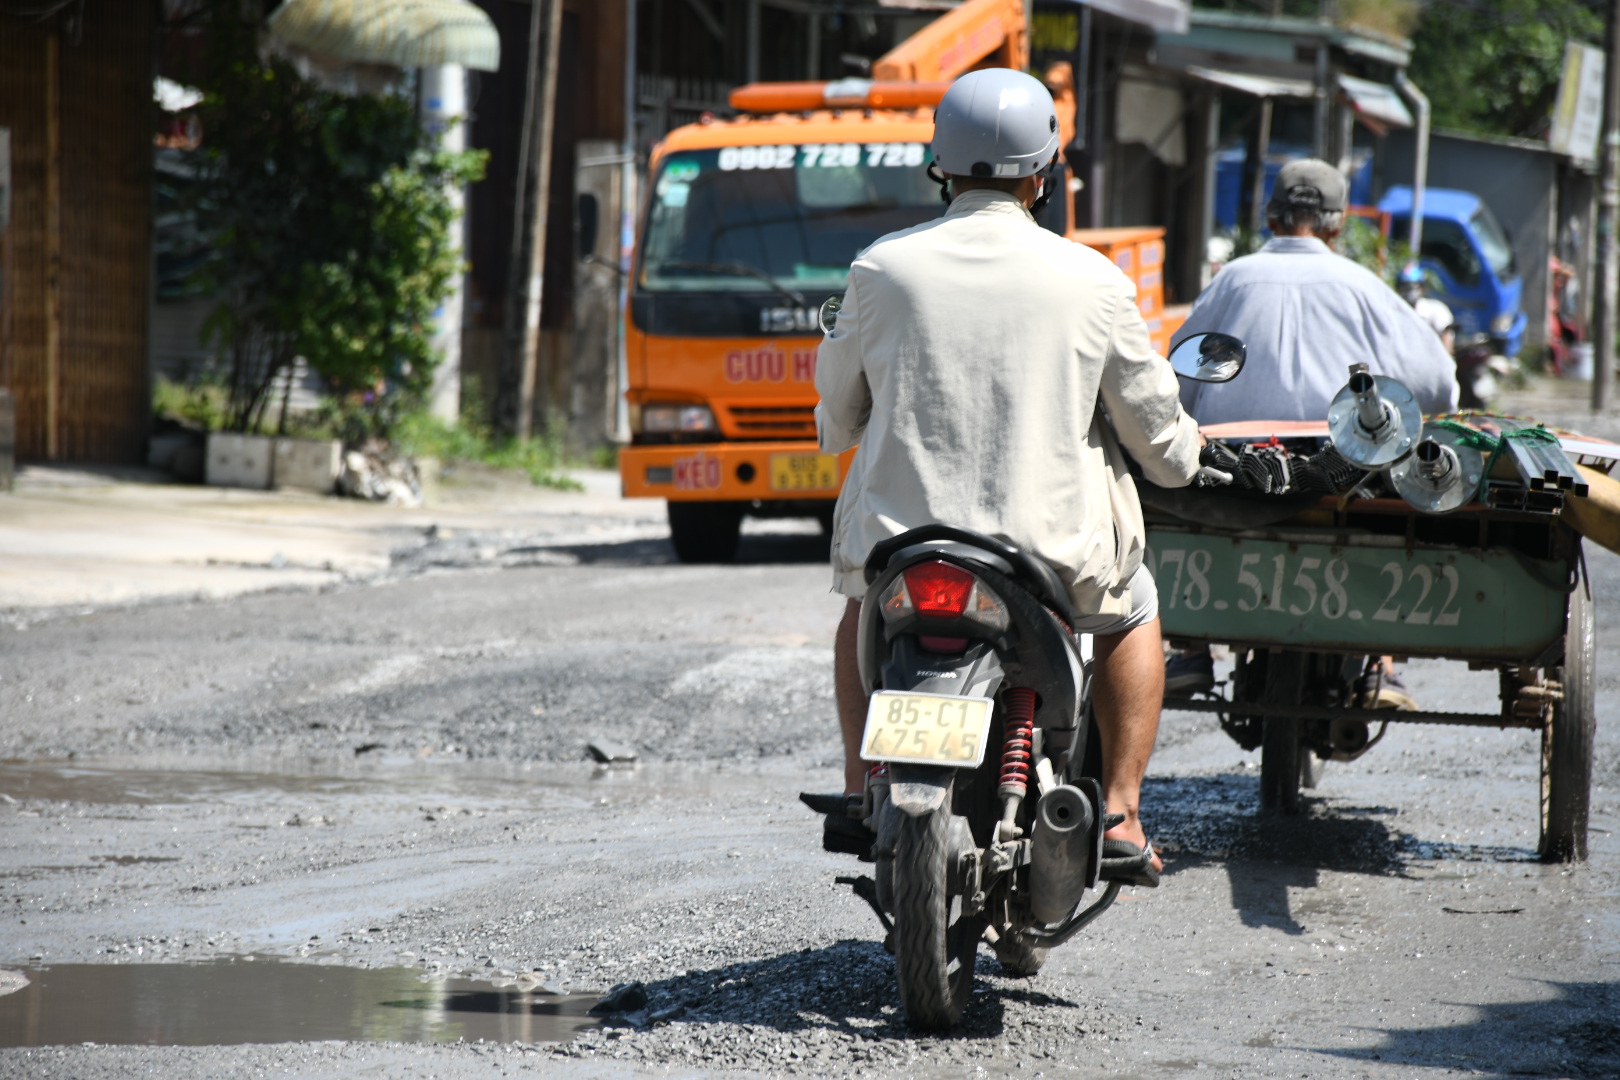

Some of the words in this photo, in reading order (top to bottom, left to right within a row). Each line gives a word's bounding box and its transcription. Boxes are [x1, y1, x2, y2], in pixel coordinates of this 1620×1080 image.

[801, 143, 861, 168] 728
[865, 142, 925, 167] 728
[761, 308, 819, 331] ISU
[916, 670, 958, 679] HONDA
[887, 698, 969, 729] 85-C1
